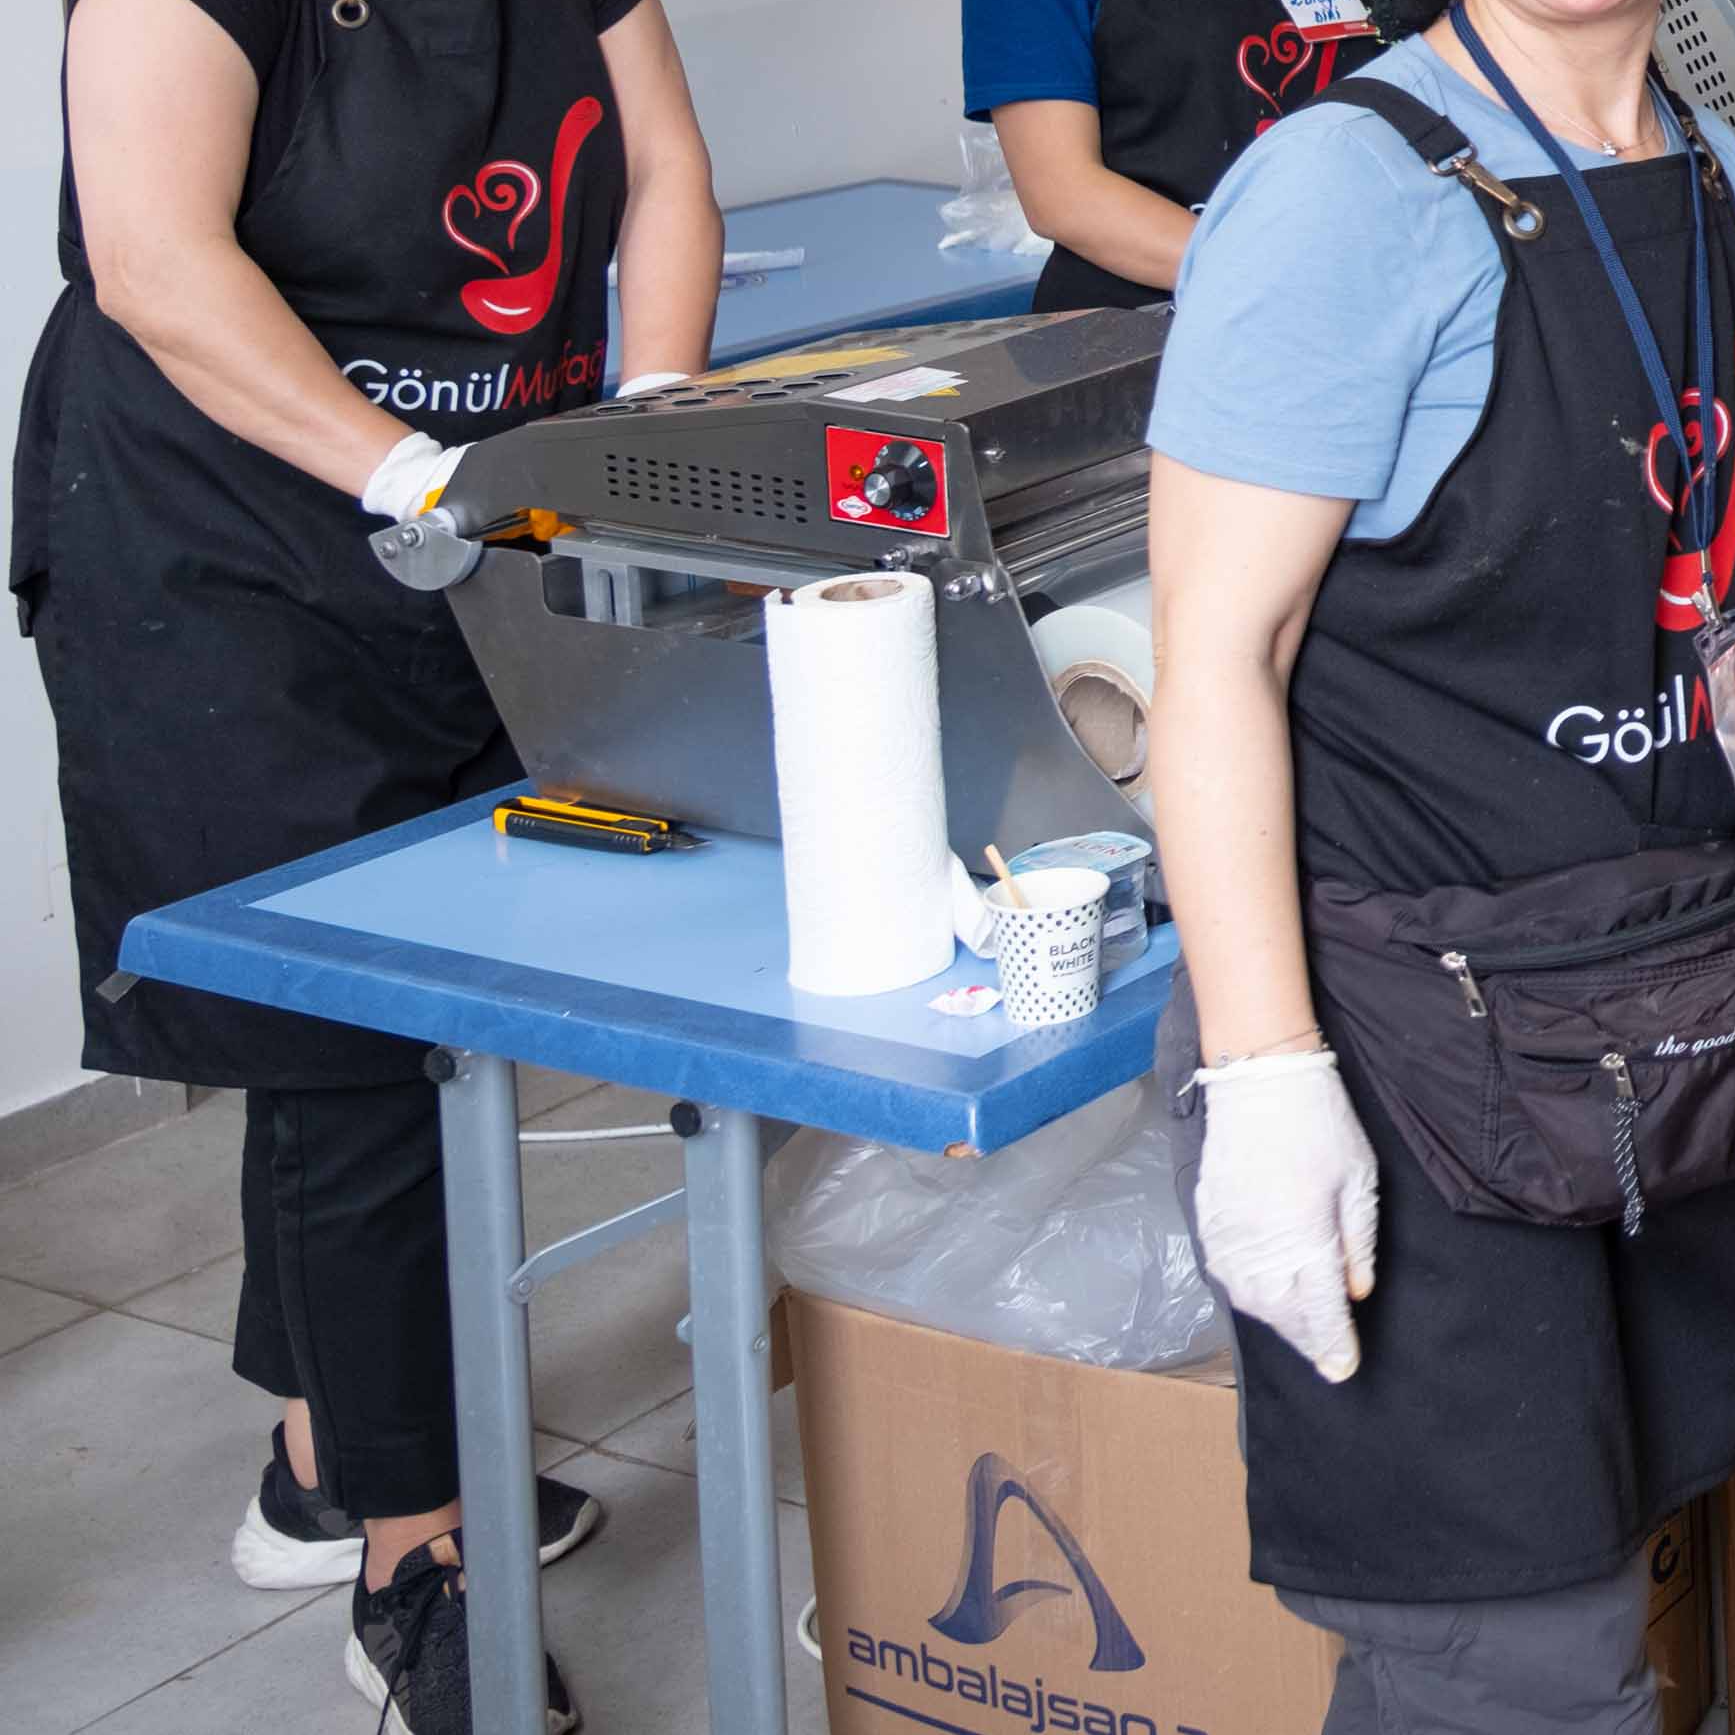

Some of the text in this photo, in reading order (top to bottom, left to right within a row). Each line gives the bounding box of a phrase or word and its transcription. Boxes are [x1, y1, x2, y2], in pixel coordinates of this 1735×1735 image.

[1049, 932, 1097, 957] BLACK
[1050, 949, 1095, 972] WHITE
[1654, 1034, 1689, 1057] the
[846, 1628, 1157, 1735] ambalajsan
